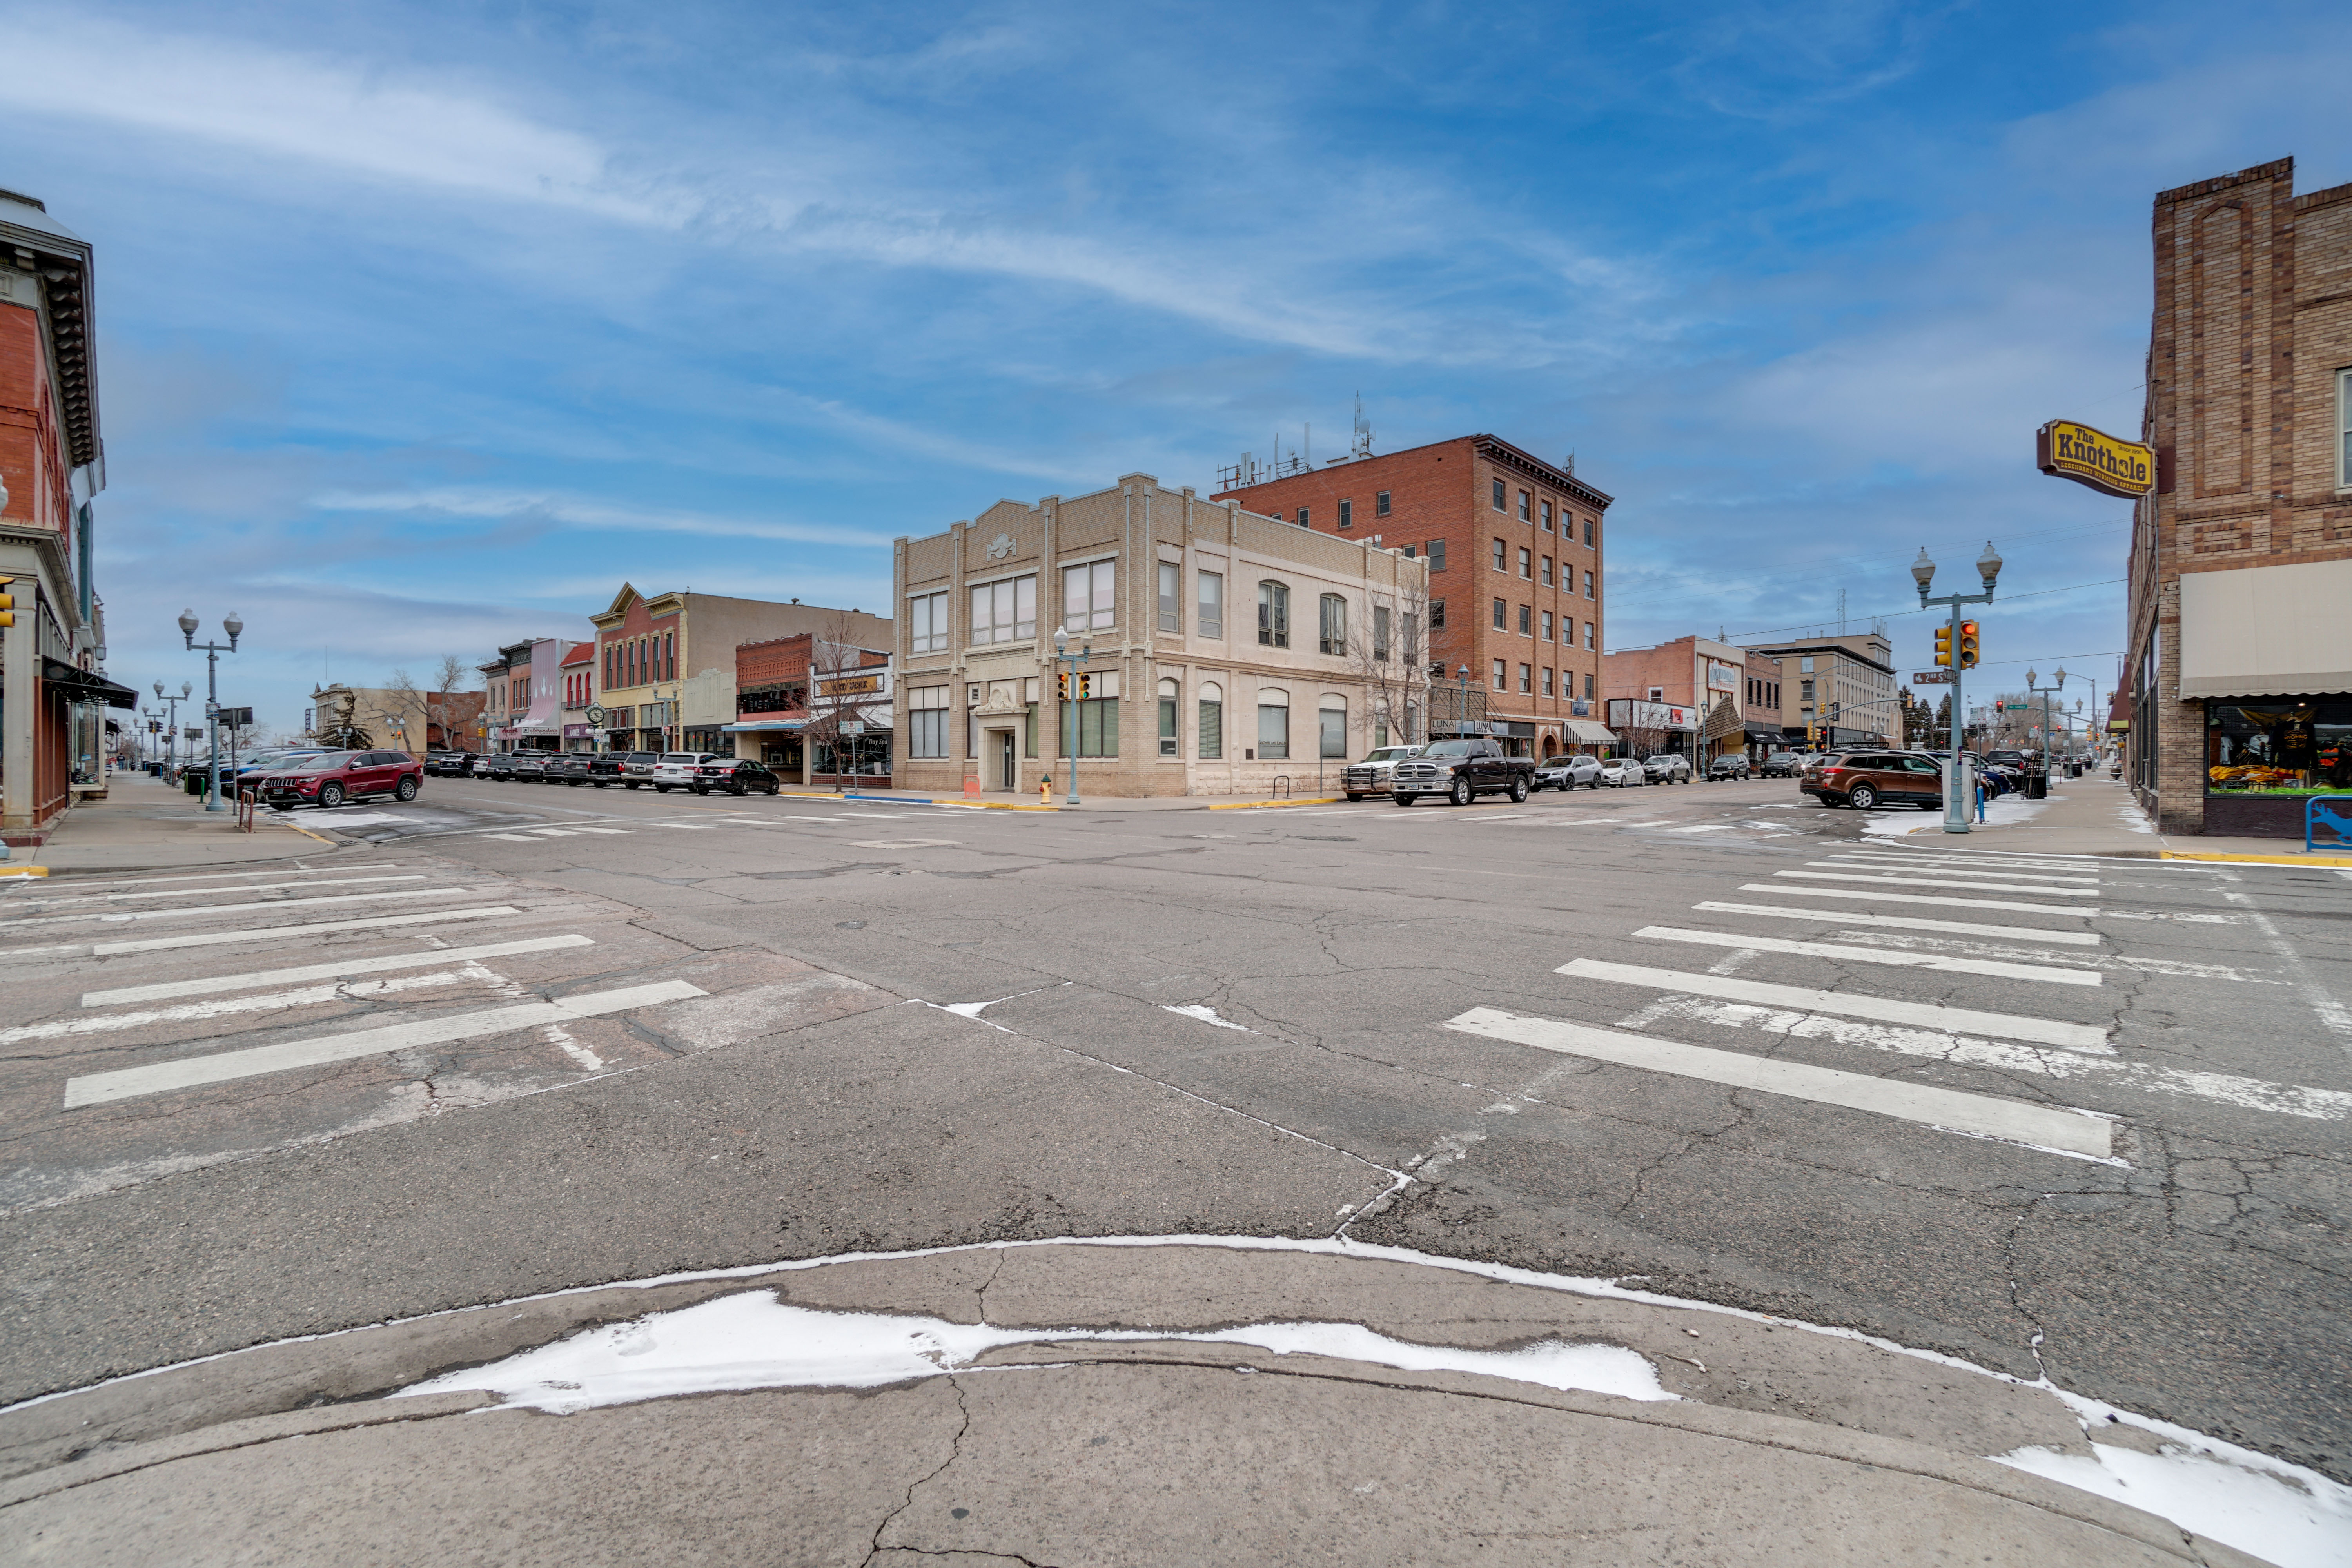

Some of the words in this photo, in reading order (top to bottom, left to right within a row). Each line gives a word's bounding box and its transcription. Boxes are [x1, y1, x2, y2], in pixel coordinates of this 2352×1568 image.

[2075, 428, 2094, 444] The
[2058, 433, 2146, 481] Knothole
[2118, 445, 2131, 453] Since
[2061, 462, 2093, 474] LEGENDARY
[2094, 471, 2118, 485] WYOMING
[2120, 481, 2145, 492] APPAREL
[1926, 673, 1937, 682] 2ND
